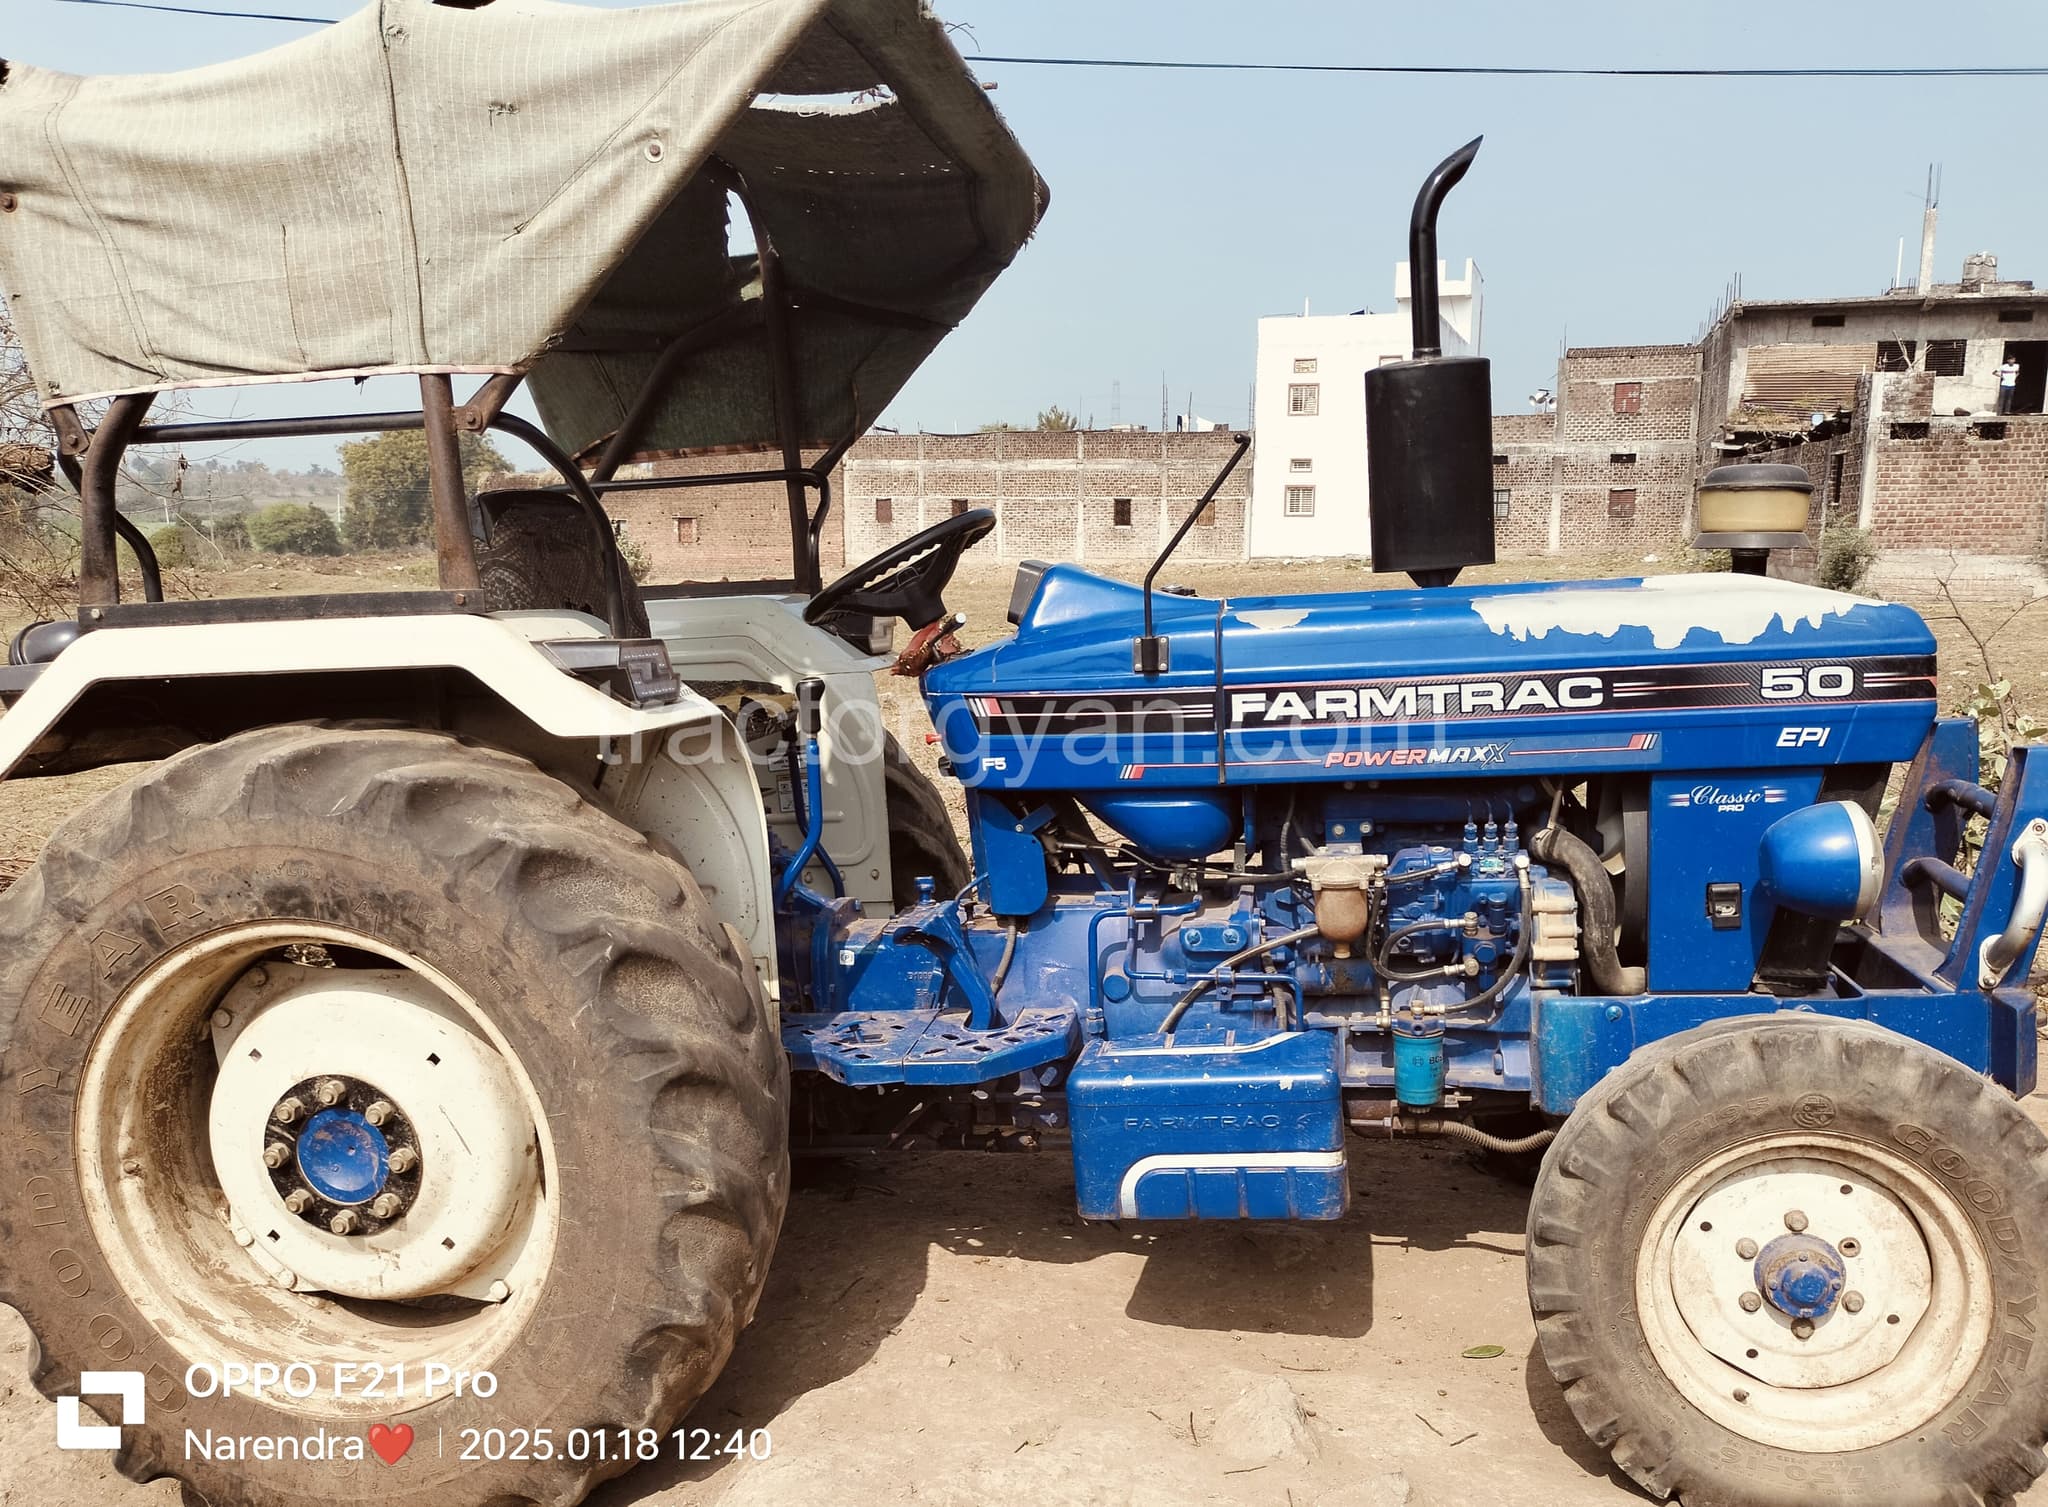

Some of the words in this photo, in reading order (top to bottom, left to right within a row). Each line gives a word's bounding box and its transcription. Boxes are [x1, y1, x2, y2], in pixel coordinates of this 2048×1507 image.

[1231, 676, 1604, 723] FARMTRAC
[1760, 665, 1855, 699] 50
[1776, 726, 1831, 748] EPI
[981, 757, 1007, 771] F5
[1689, 785, 1764, 806] Classic
[1717, 803, 1745, 813] PRO
[1123, 1114, 1281, 1132] FARMTRAC
